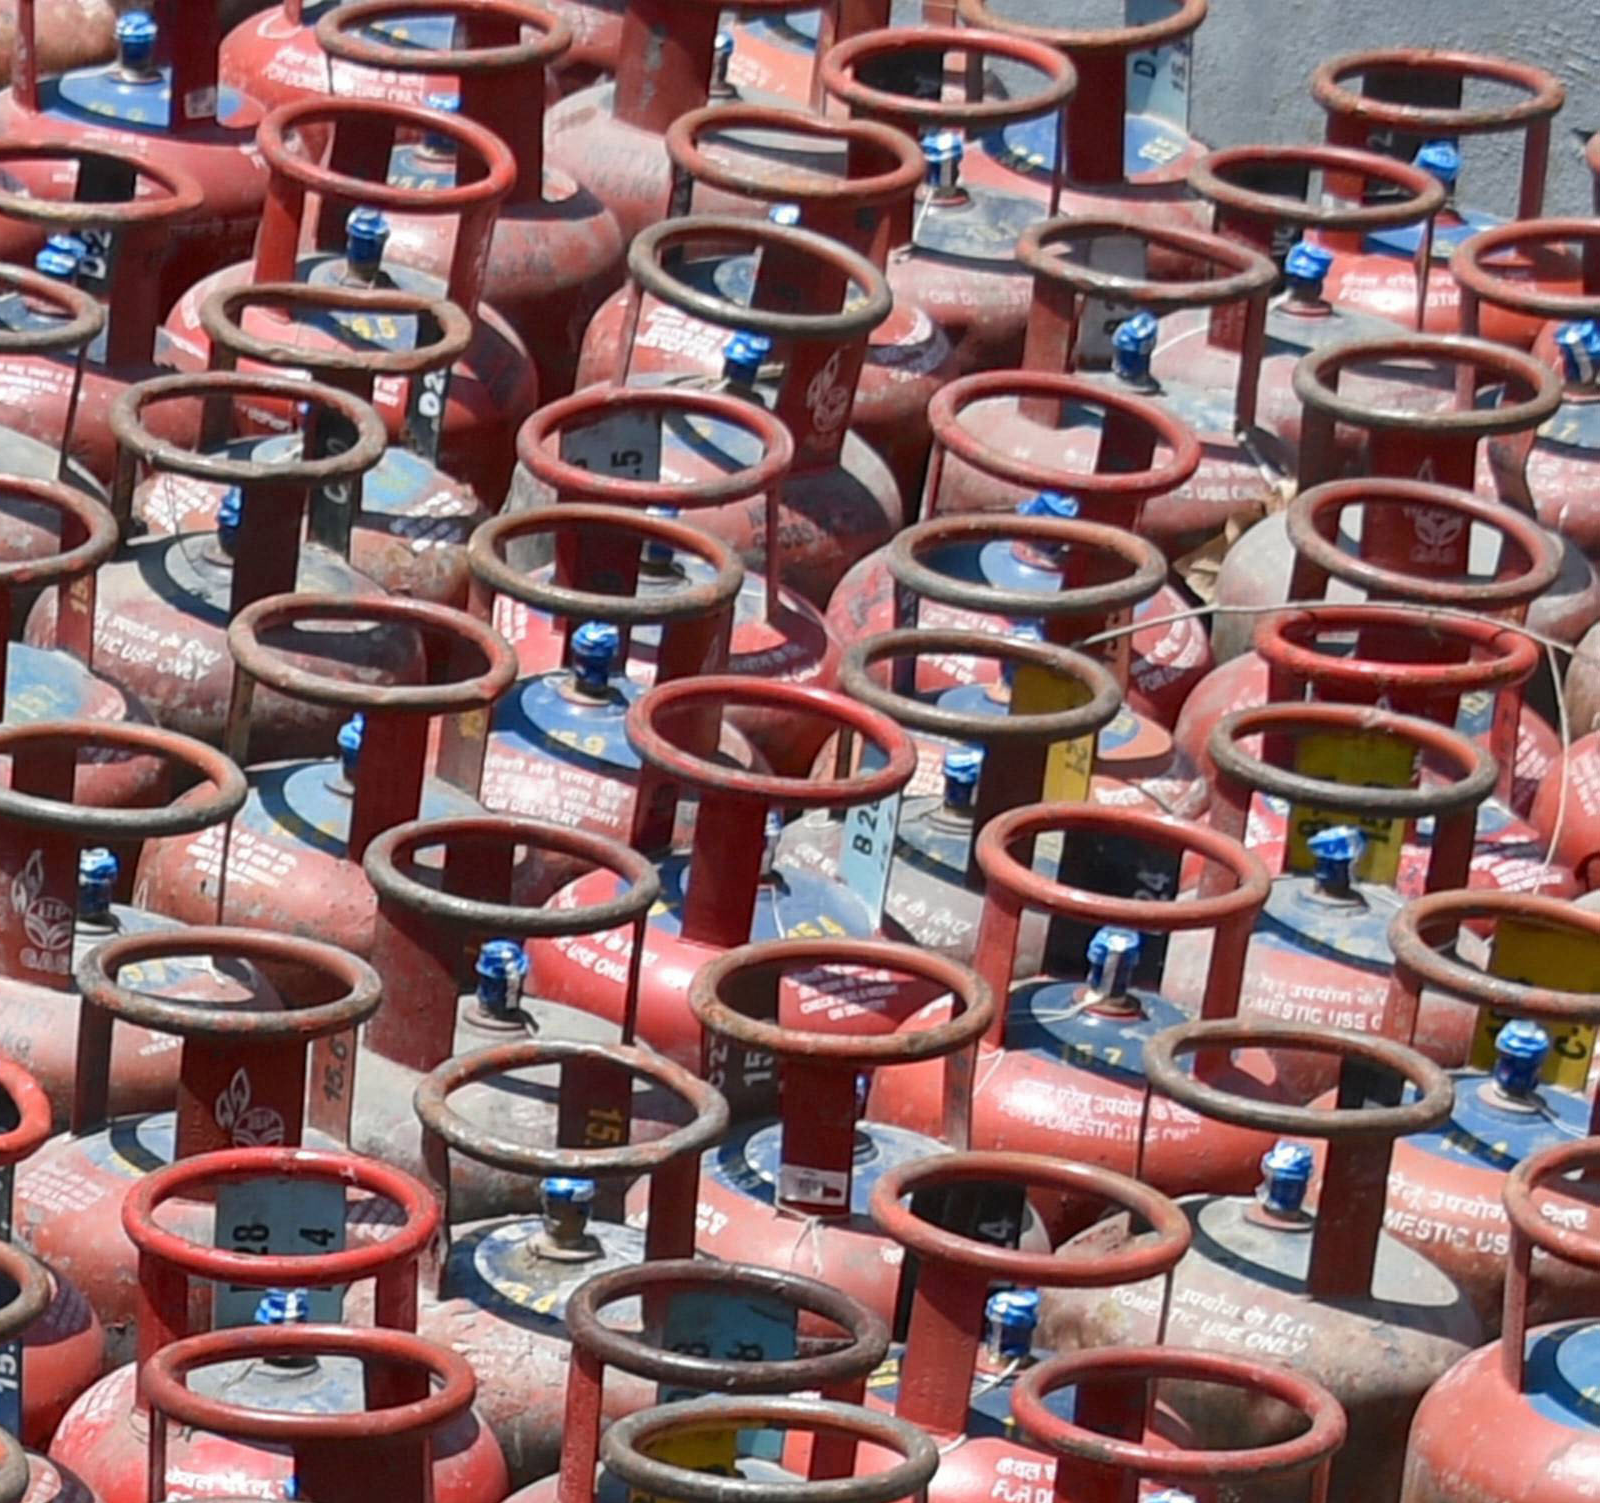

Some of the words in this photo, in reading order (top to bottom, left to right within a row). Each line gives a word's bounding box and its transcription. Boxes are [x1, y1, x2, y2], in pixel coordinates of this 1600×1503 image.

[1385, 1207, 1470, 1248] MESTIC
[1476, 1230, 1510, 1256] US
[1243, 1330, 1308, 1355] ONLY
